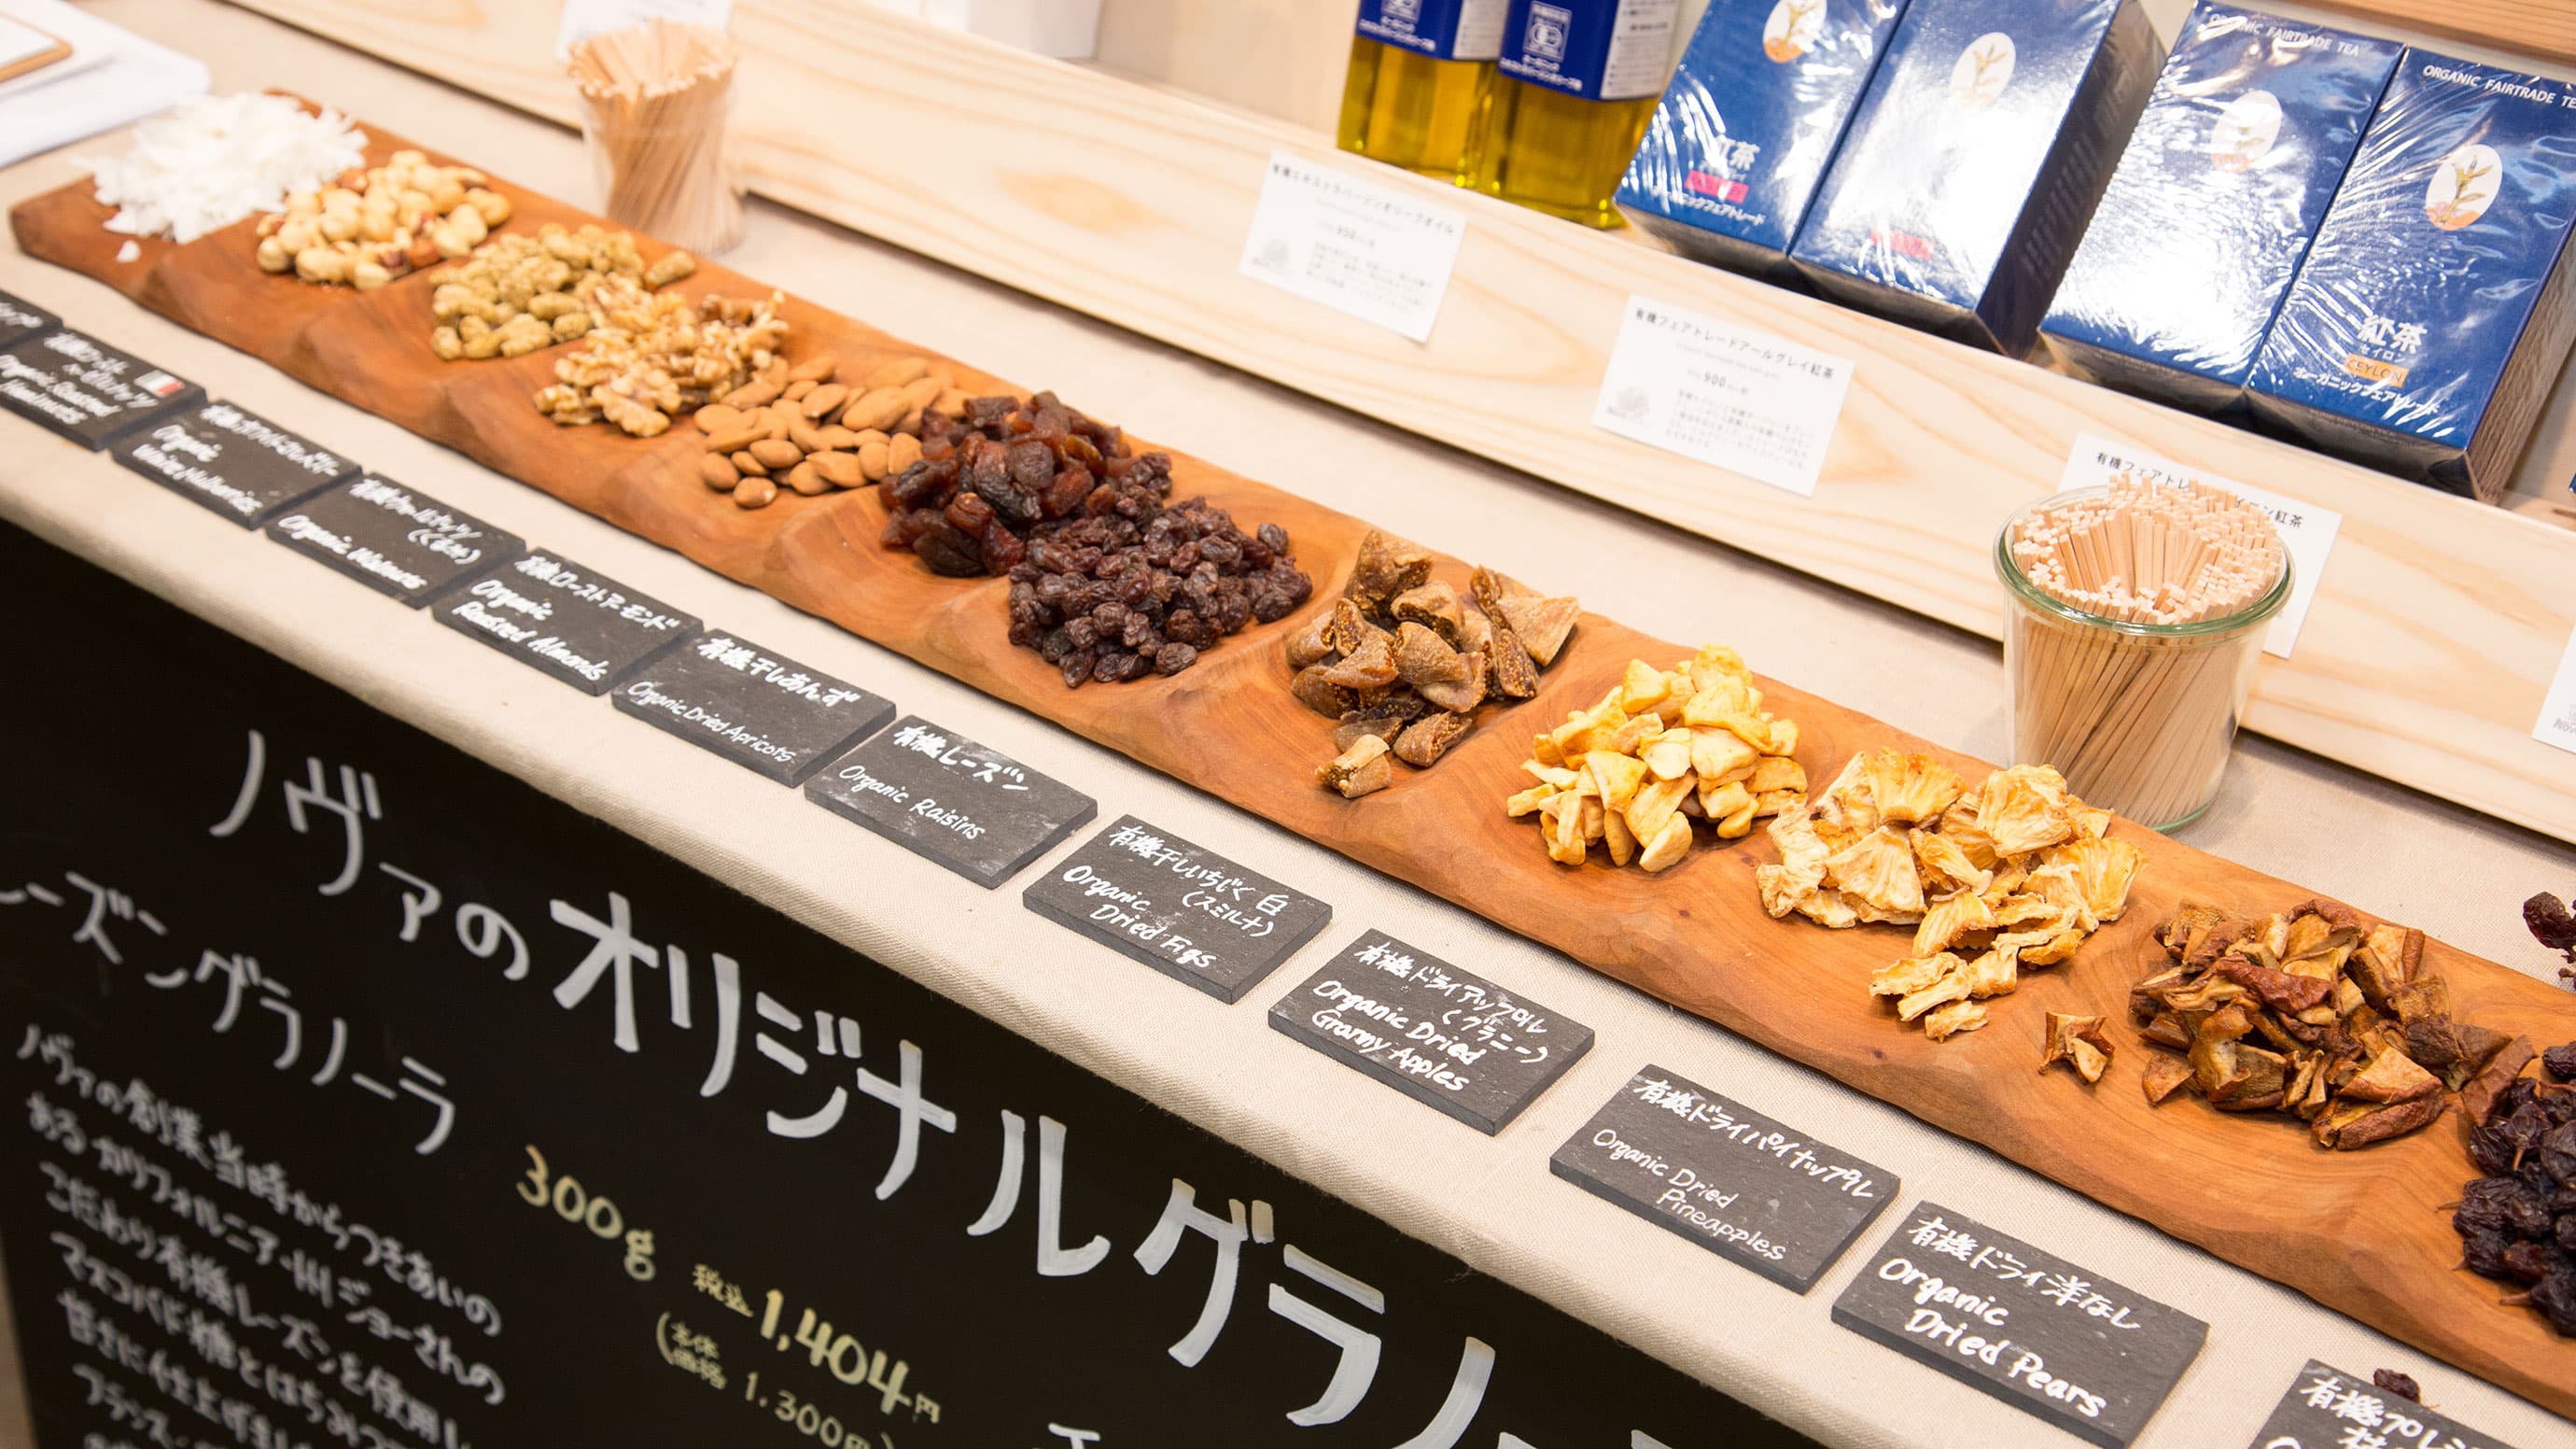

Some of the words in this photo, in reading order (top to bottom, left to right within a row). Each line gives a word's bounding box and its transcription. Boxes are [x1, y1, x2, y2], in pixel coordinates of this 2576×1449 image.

[2208, 12, 2265, 38] ORNIC
[2267, 25, 2332, 50] FAIRTRADE
[2336, 42, 2360, 57] TEA
[2422, 64, 2481, 88] ORGANIC
[2485, 78, 2556, 104] FAIRTRADE
[1635, 307, 1834, 380] 有機フェアトレードアールグレイ紅茶
[2357, 315, 2428, 354] 紅茶
[2359, 344, 2406, 363] セイロン
[2346, 359, 2403, 383] CEYLON
[278, 514, 354, 556] Organic
[469, 579, 554, 621] Organic
[452, 600, 539, 643] Roasted
[526, 636, 609, 682] Almonds
[697, 637, 861, 709] 有機干しあんず
[627, 681, 688, 715] Organic
[682, 701, 730, 736] Dried
[723, 724, 797, 764] Apricots
[892, 724, 1029, 792] 有機レーズン
[838, 765, 910, 805] Organic
[909, 797, 987, 841] Raisins
[1062, 865, 1152, 913] Organic
[1108, 824, 1257, 902] 有機干しいちじく
[1255, 893, 1290, 917] 白
[1089, 903, 1167, 942] Dried
[1160, 935, 1218, 969] Figs
[1311, 979, 1409, 1030] Organic
[1406, 1021, 1488, 1067] Dried
[1442, 1009, 1549, 1064] (グラニー)
[208, 729, 1675, 1449] ノヴァのオリジナルグラノ
[1388, 1047, 1472, 1092] Apples
[1592, 1129, 1670, 1178] Organic
[1668, 1168, 1740, 1210] Dried
[1633, 1078, 1874, 1199] 有機ドライパイナップル
[515, 1144, 656, 1282] 300g
[1656, 1189, 1787, 1261] Pineapples
[692, 1263, 754, 1318] 税込
[1878, 1257, 2010, 1327] Organic
[1907, 1217, 2142, 1331] 有機ドライ洋なし
[1904, 1308, 2011, 1367] Dried
[2007, 1350, 2107, 1418] Pears
